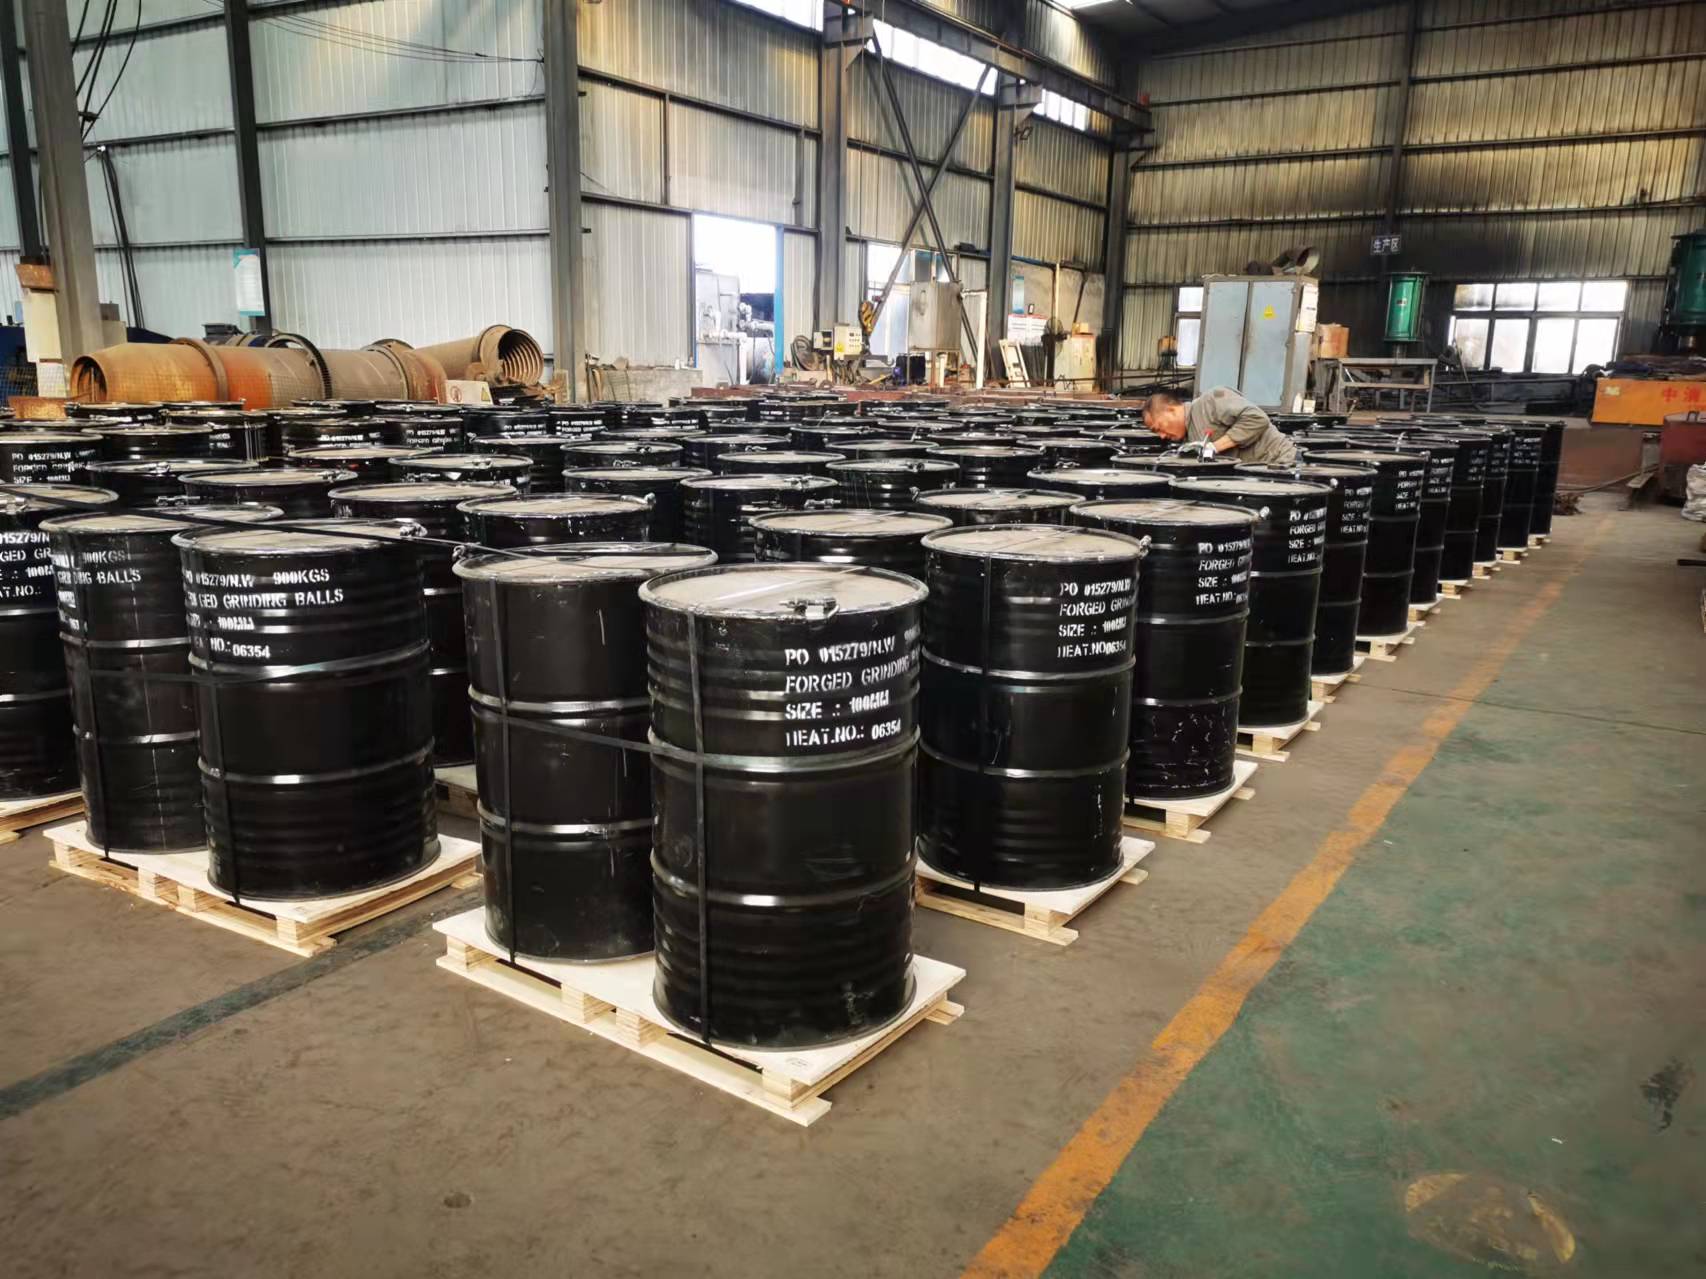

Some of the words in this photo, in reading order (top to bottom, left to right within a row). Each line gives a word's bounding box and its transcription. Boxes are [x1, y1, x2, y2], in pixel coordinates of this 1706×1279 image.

[1198, 542, 1214, 554] PO
[96, 567, 142, 584] BALLS
[273, 568, 330, 585] 900KGS
[1198, 576, 1219, 588] SIZE
[1059, 582, 1079, 596] PO
[223, 593, 287, 610] GRINDING
[294, 588, 344, 606] BALLS
[1059, 601, 1106, 617] FORGED
[1058, 623, 1086, 637] SIZE
[232, 645, 271, 659] 06354
[784, 648, 810, 666] PO
[785, 671, 853, 694] FORGED
[784, 701, 823, 720] SIZE
[870, 718, 902, 740] 06354
